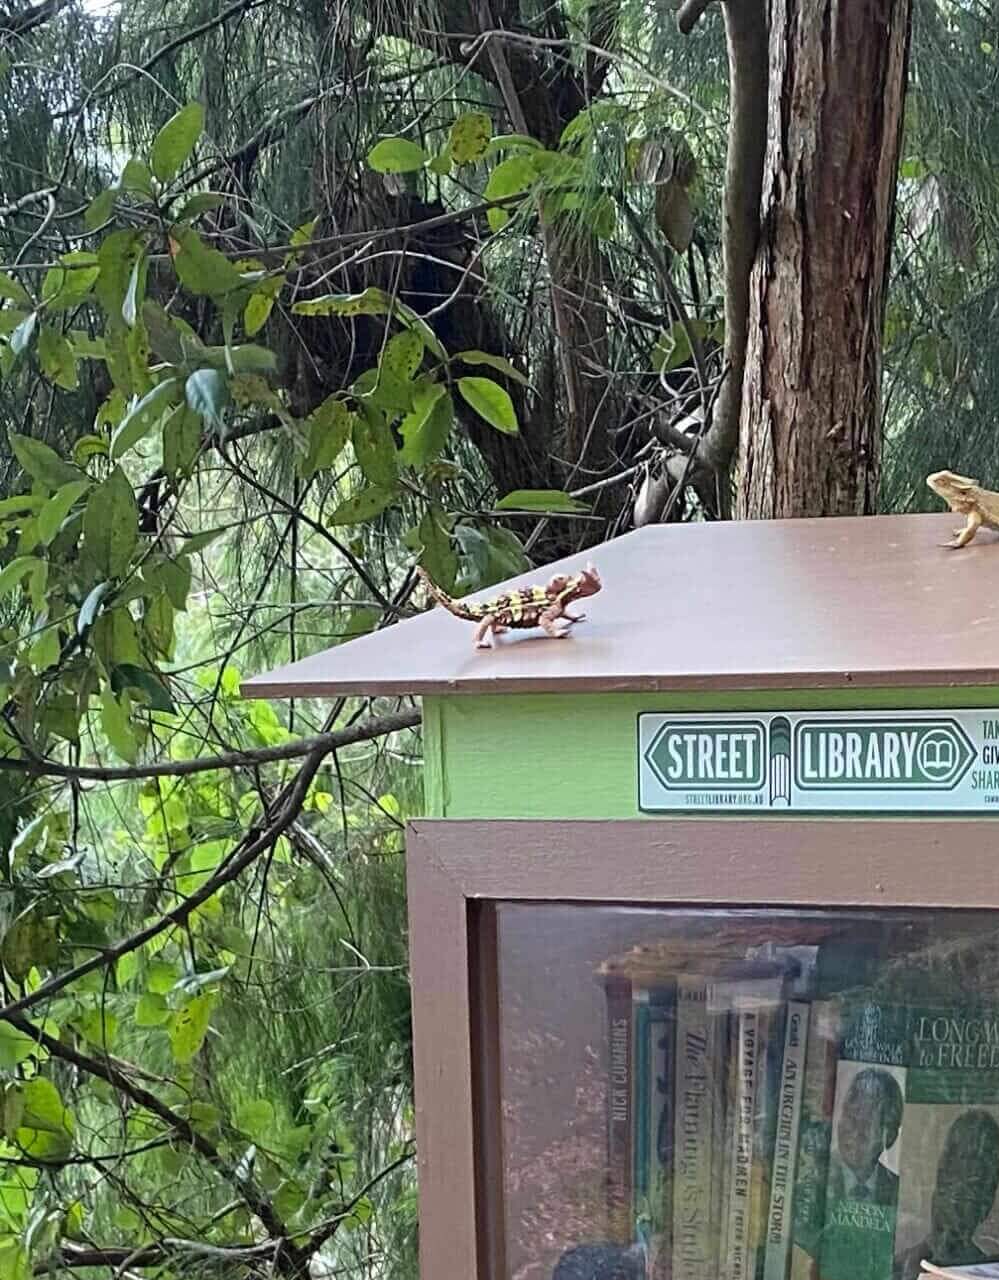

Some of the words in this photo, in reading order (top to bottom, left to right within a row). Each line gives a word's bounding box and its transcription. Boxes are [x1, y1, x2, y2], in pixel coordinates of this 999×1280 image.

[667, 733, 757, 779] STREET
[804, 731, 919, 779] LIBRARY
[685, 793, 764, 805] STREETLIBRARY.ORG.AU
[745, 1012, 757, 1021] A
[918, 1016, 981, 1044] LONG
[609, 1016, 627, 1084] CUMMINS
[686, 1032, 708, 1062] The
[743, 1028, 757, 1089] VOYAGE
[918, 1047, 935, 1067] to
[785, 1057, 799, 1080] AN
[610, 1088, 627, 1121] NICK
[740, 1095, 754, 1124] FOR
[778, 1084, 797, 1140] URCHIN
[777, 1142, 791, 1159] IN
[736, 1133, 753, 1197] MADMEN
[774, 1163, 790, 1191] THE
[768, 1196, 787, 1245] STORM
[830, 1211, 891, 1233] MANDELA
[839, 1199, 889, 1219] NELSON
